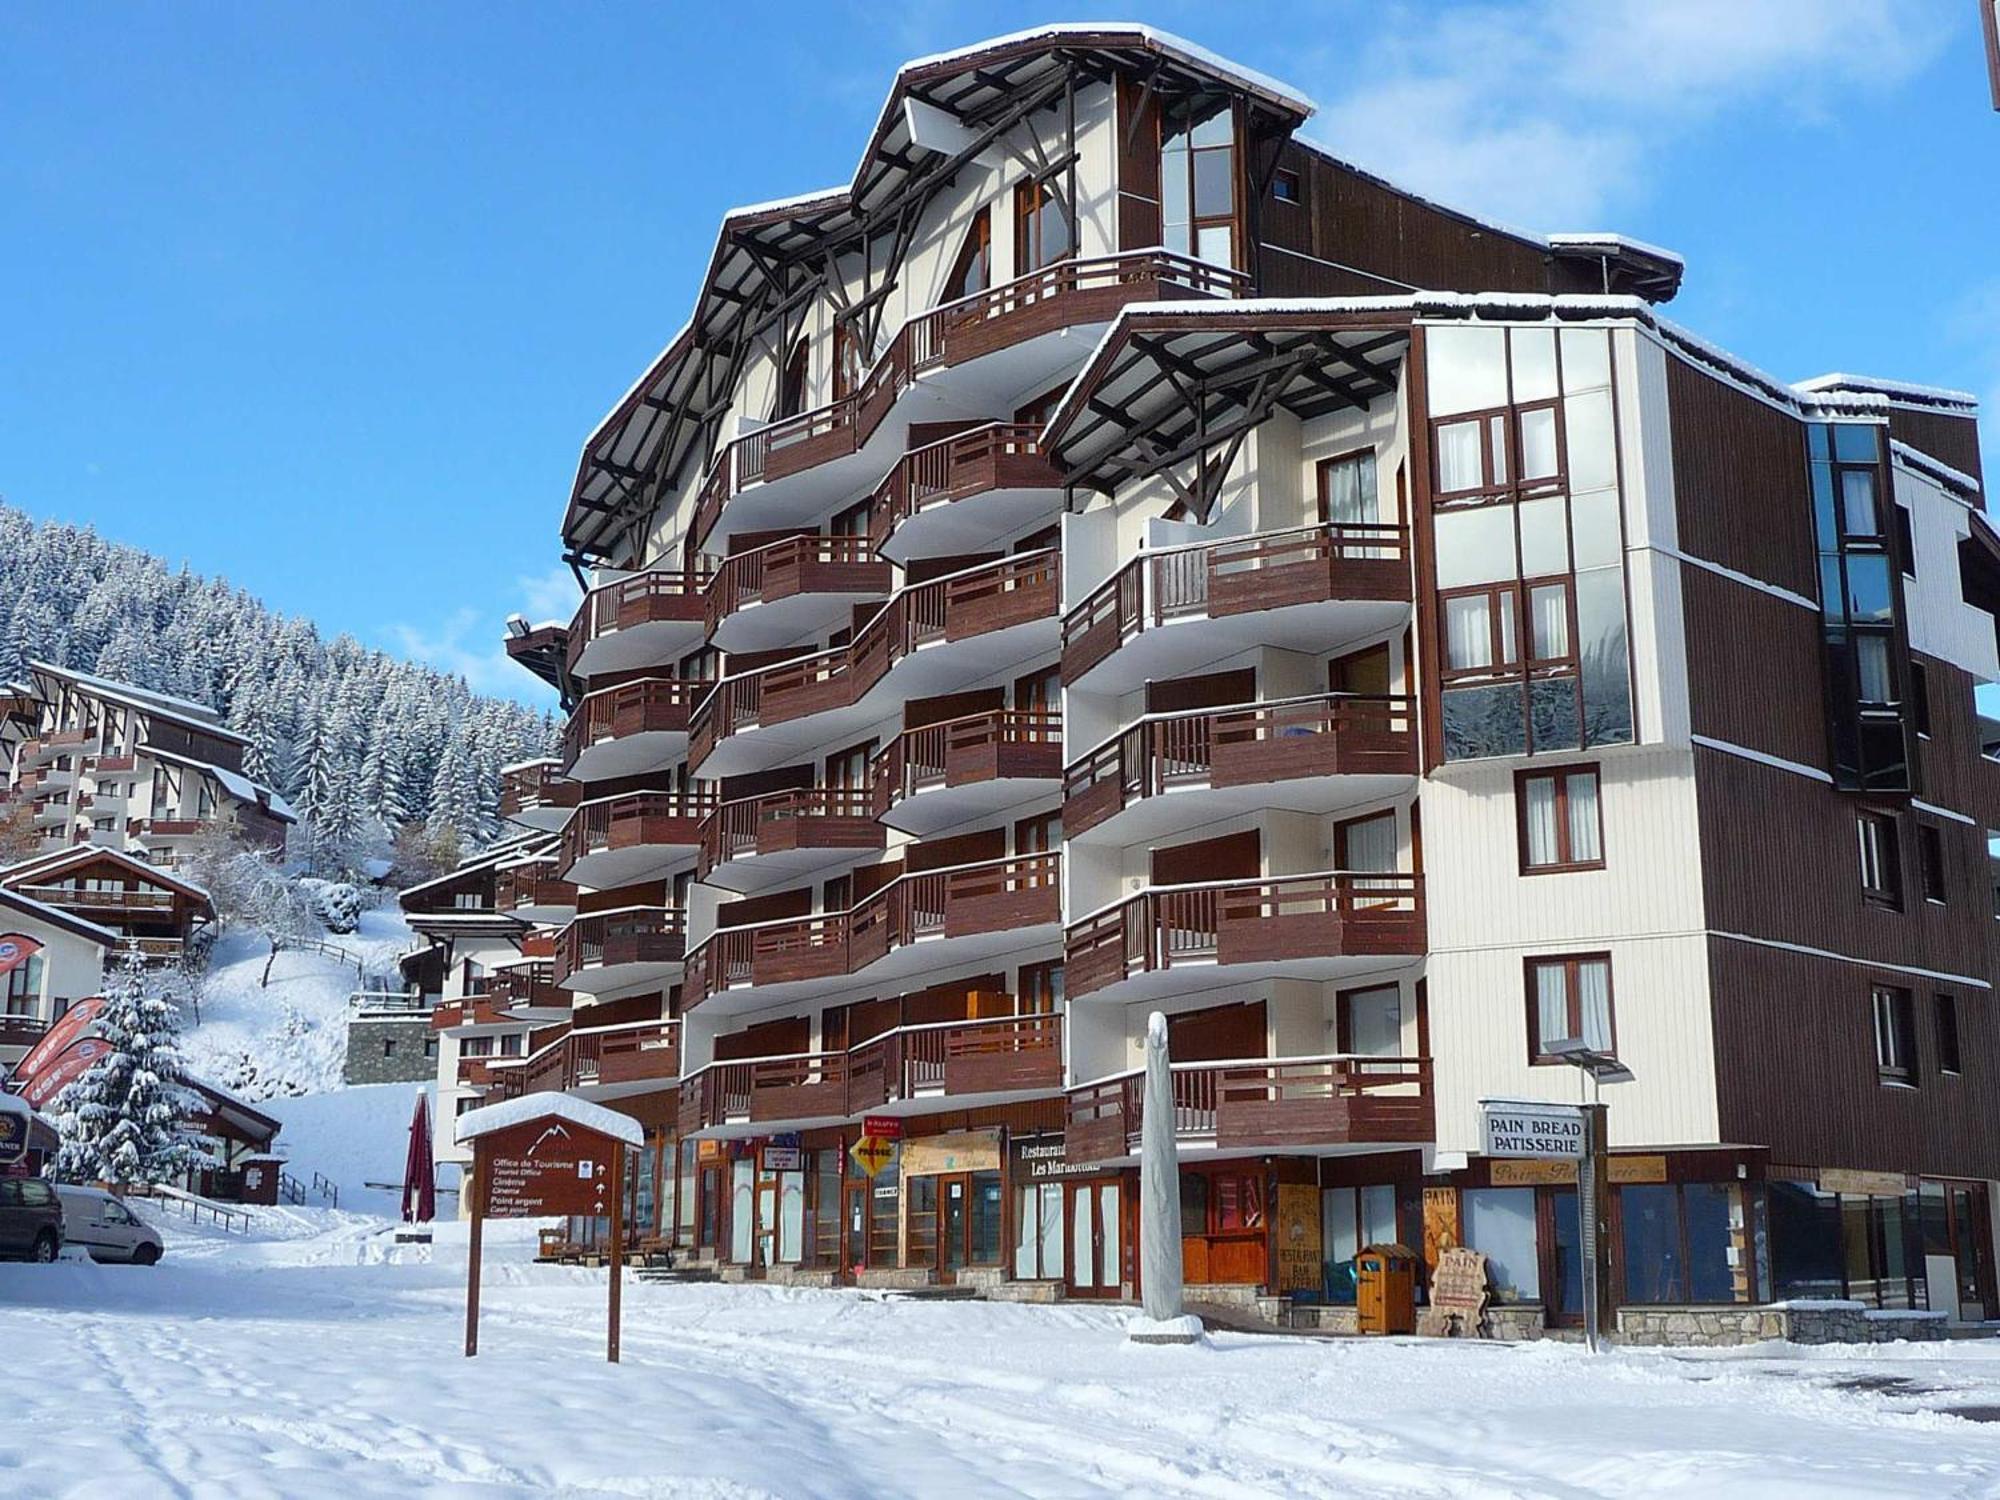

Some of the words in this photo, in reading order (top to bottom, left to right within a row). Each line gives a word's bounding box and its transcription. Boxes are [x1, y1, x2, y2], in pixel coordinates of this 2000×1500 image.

[1491, 1119, 1524, 1133] PAIN
[1532, 1121, 1581, 1136] BREAD
[1495, 1136, 1579, 1153] PATISSERIE
[493, 1159, 519, 1168] Office
[520, 1160, 532, 1168] de
[534, 1160, 574, 1169] Tourisme
[1031, 1162, 1046, 1177] Les
[492, 1177, 526, 1187] Cinéma
[490, 1196, 513, 1205] Point
[514, 1198, 543, 1207] argent
[1424, 1190, 1455, 1206] PAIN
[1444, 1256, 1478, 1269] PAIN
